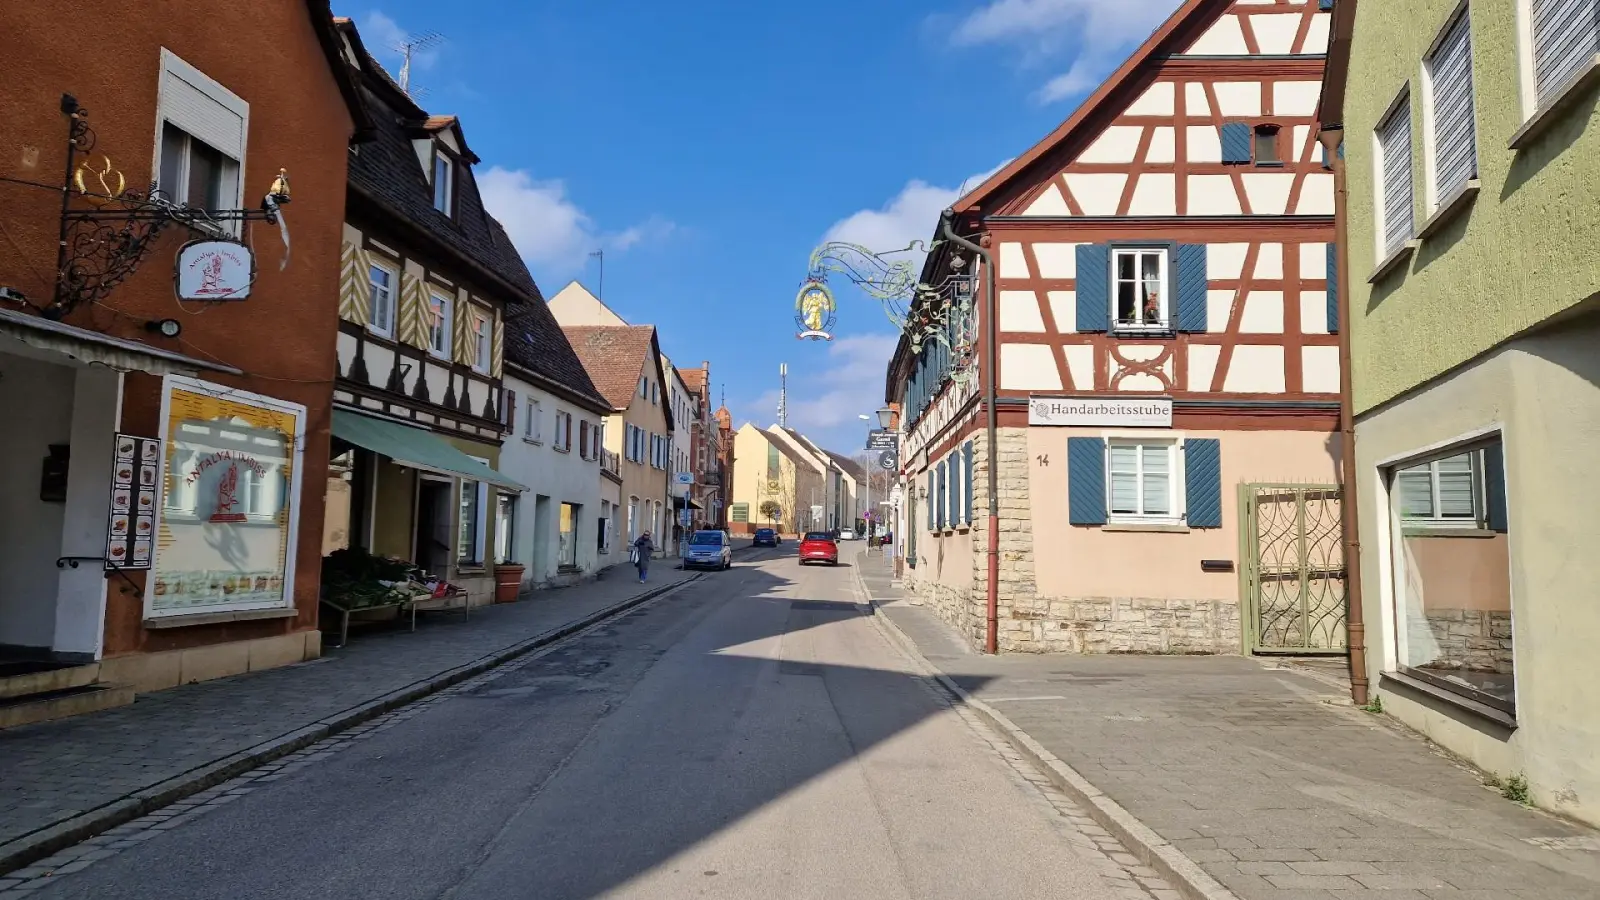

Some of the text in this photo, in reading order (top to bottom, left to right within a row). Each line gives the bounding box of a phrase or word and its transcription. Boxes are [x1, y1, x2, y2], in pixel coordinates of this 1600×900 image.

[1051, 403, 1170, 416] Handarbeitsstube
[1036, 453, 1050, 467] 14
[186, 450, 267, 488] ANTALYA IMBISS
